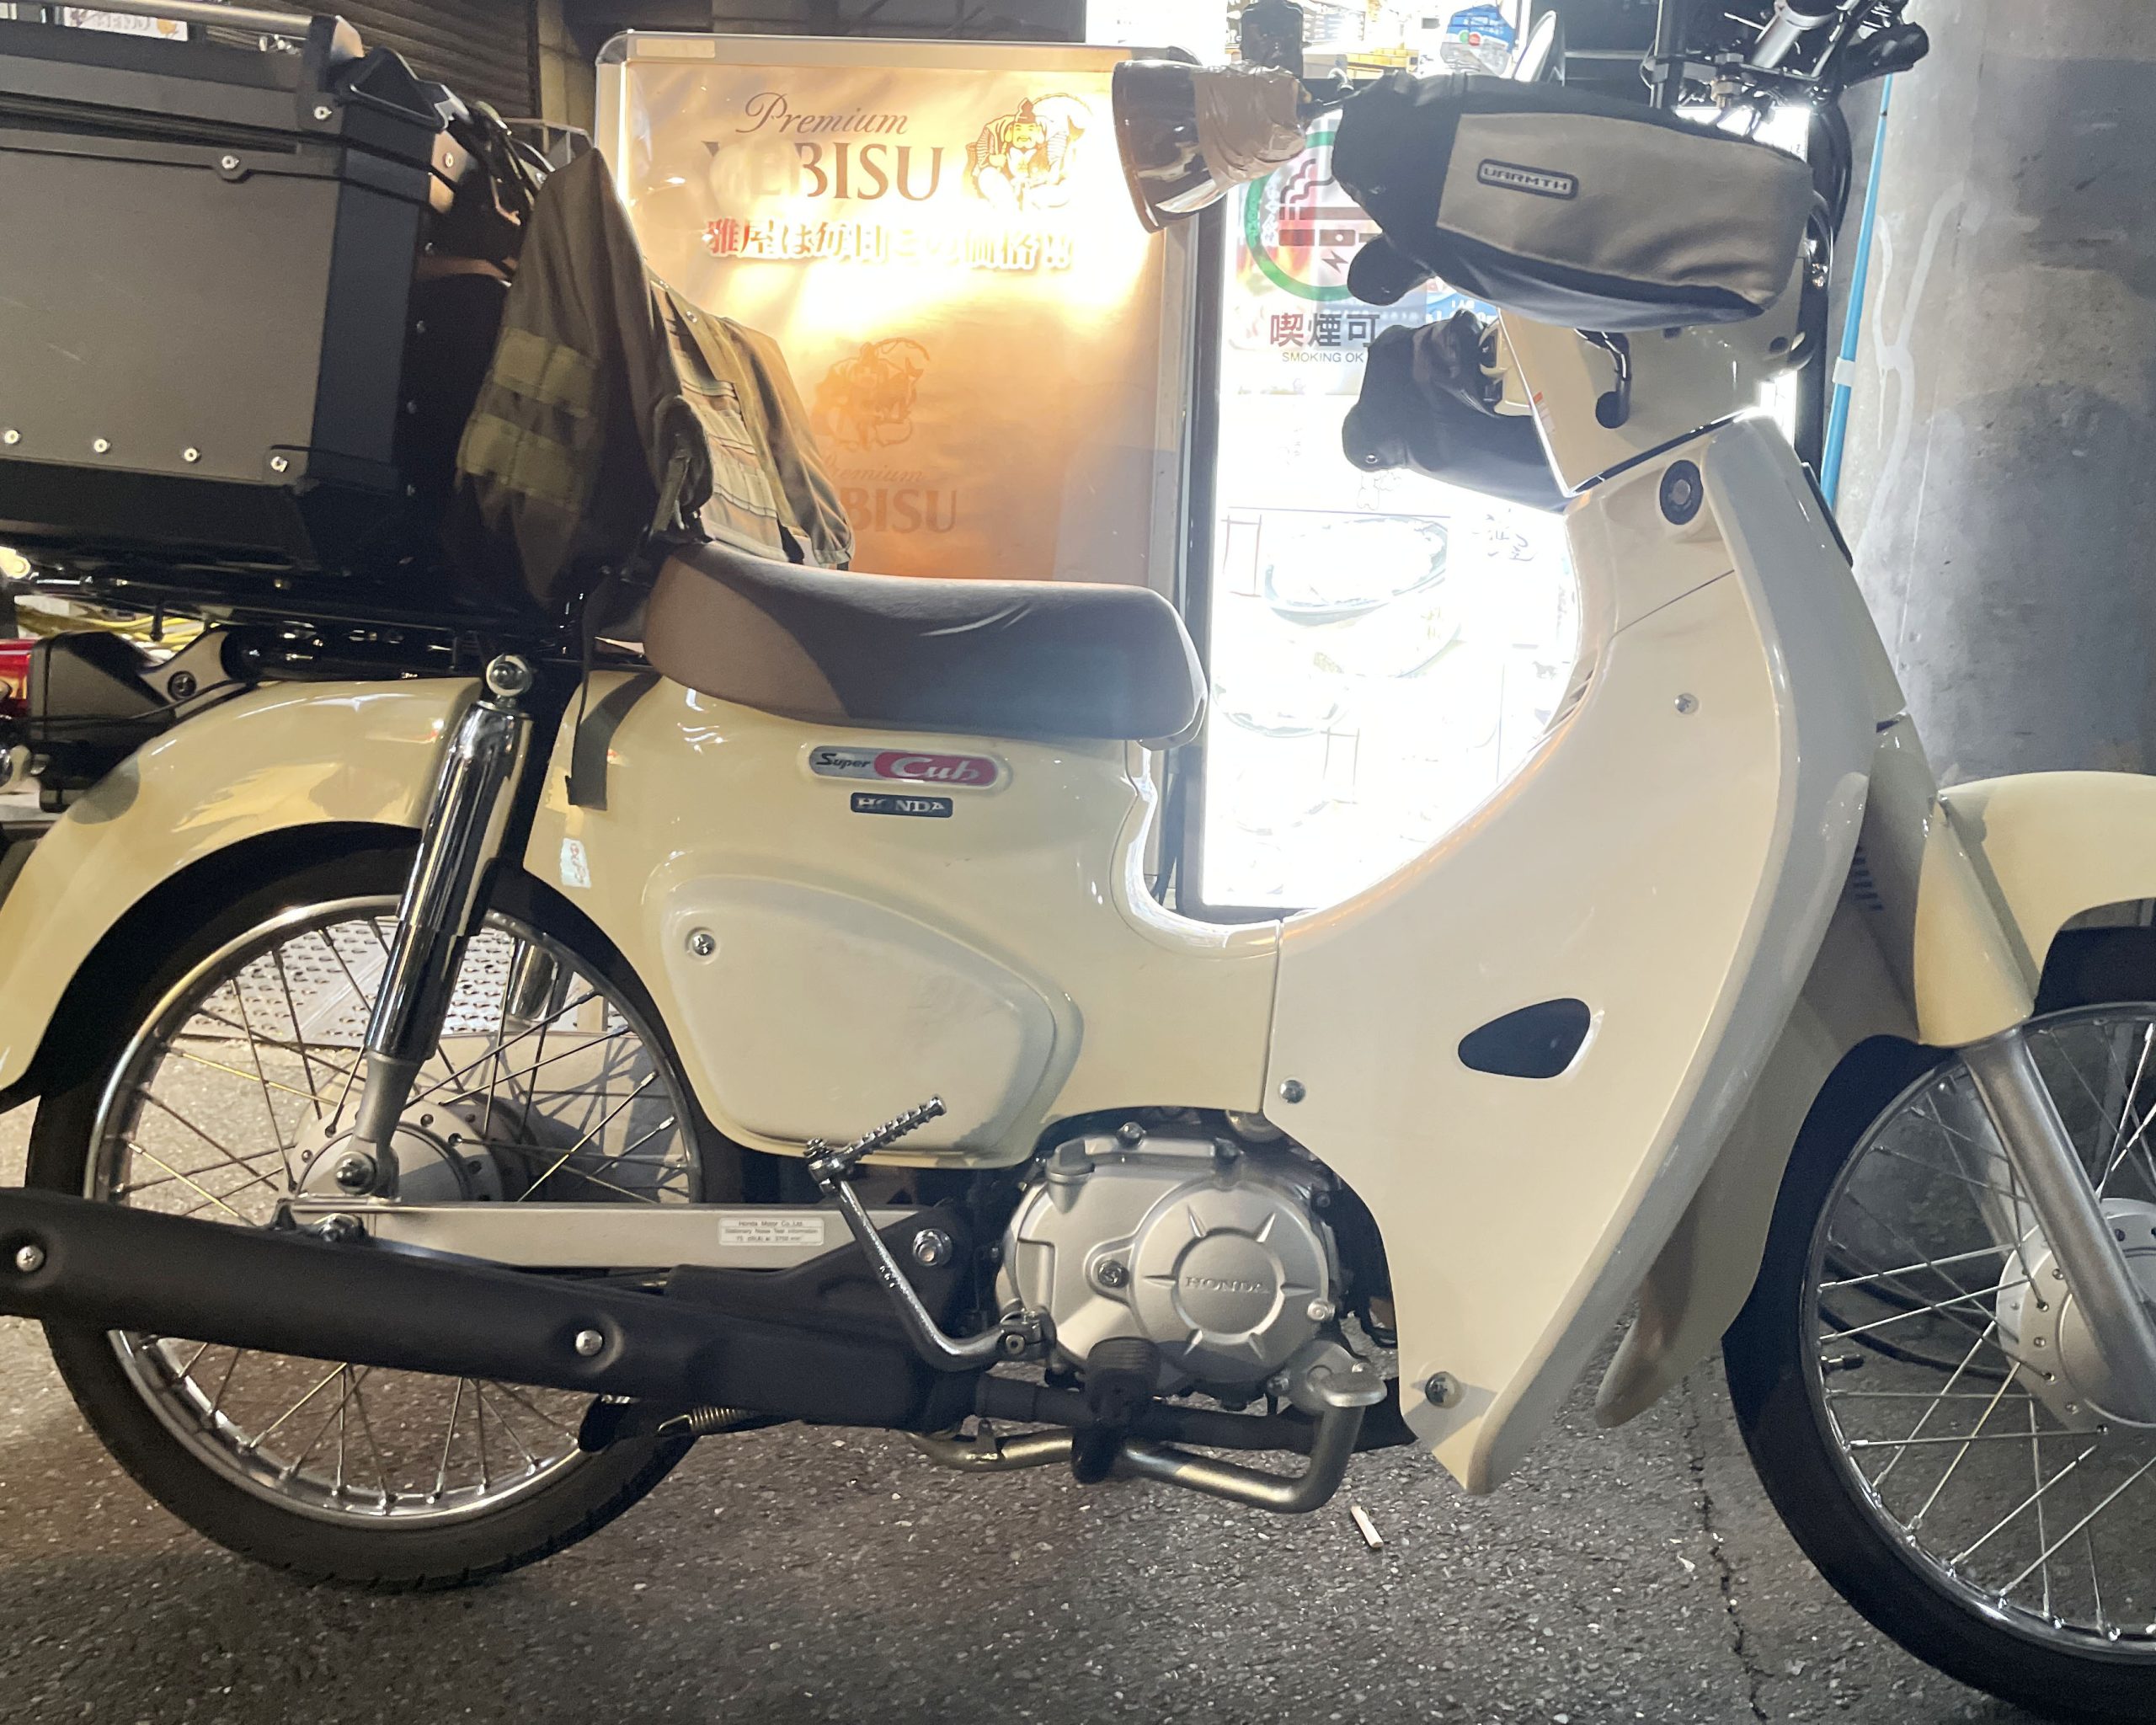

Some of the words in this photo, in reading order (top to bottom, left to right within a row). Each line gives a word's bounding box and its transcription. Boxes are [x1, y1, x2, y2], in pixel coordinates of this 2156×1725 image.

[735, 92, 908, 135] Premium
[701, 140, 945, 201] BISU
[1269, 312, 1380, 348] 喫煙可
[1282, 352, 1342, 363] SMOKING
[1345, 352, 1364, 363] OK
[815, 752, 871, 769] Super
[890, 756, 979, 781] Cub
[857, 798, 946, 813] HNDA
[1185, 1276, 1271, 1294] HONDA
